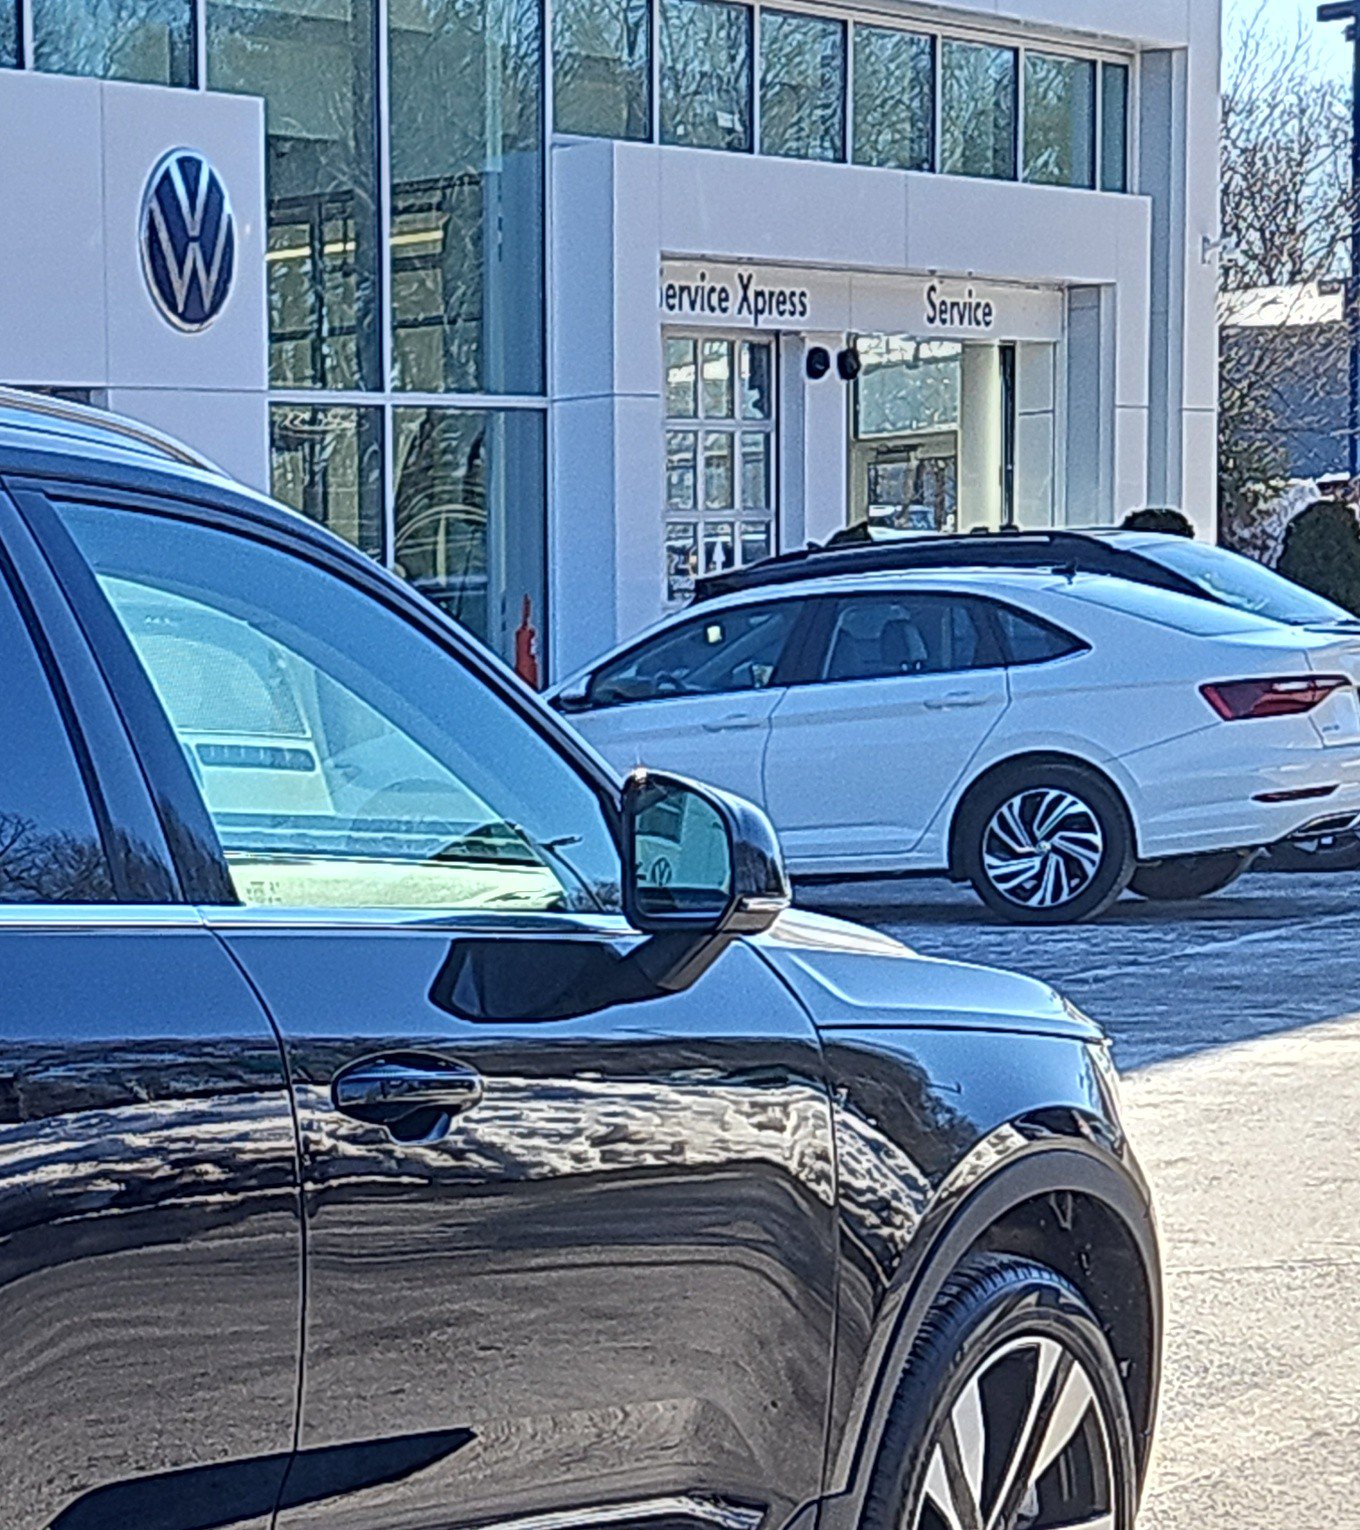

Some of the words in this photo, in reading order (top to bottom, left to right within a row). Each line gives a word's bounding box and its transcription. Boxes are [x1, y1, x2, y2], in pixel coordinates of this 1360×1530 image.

[146, 154, 234, 317] VW
[737, 272, 809, 326] Xpress
[925, 284, 993, 328] Service
